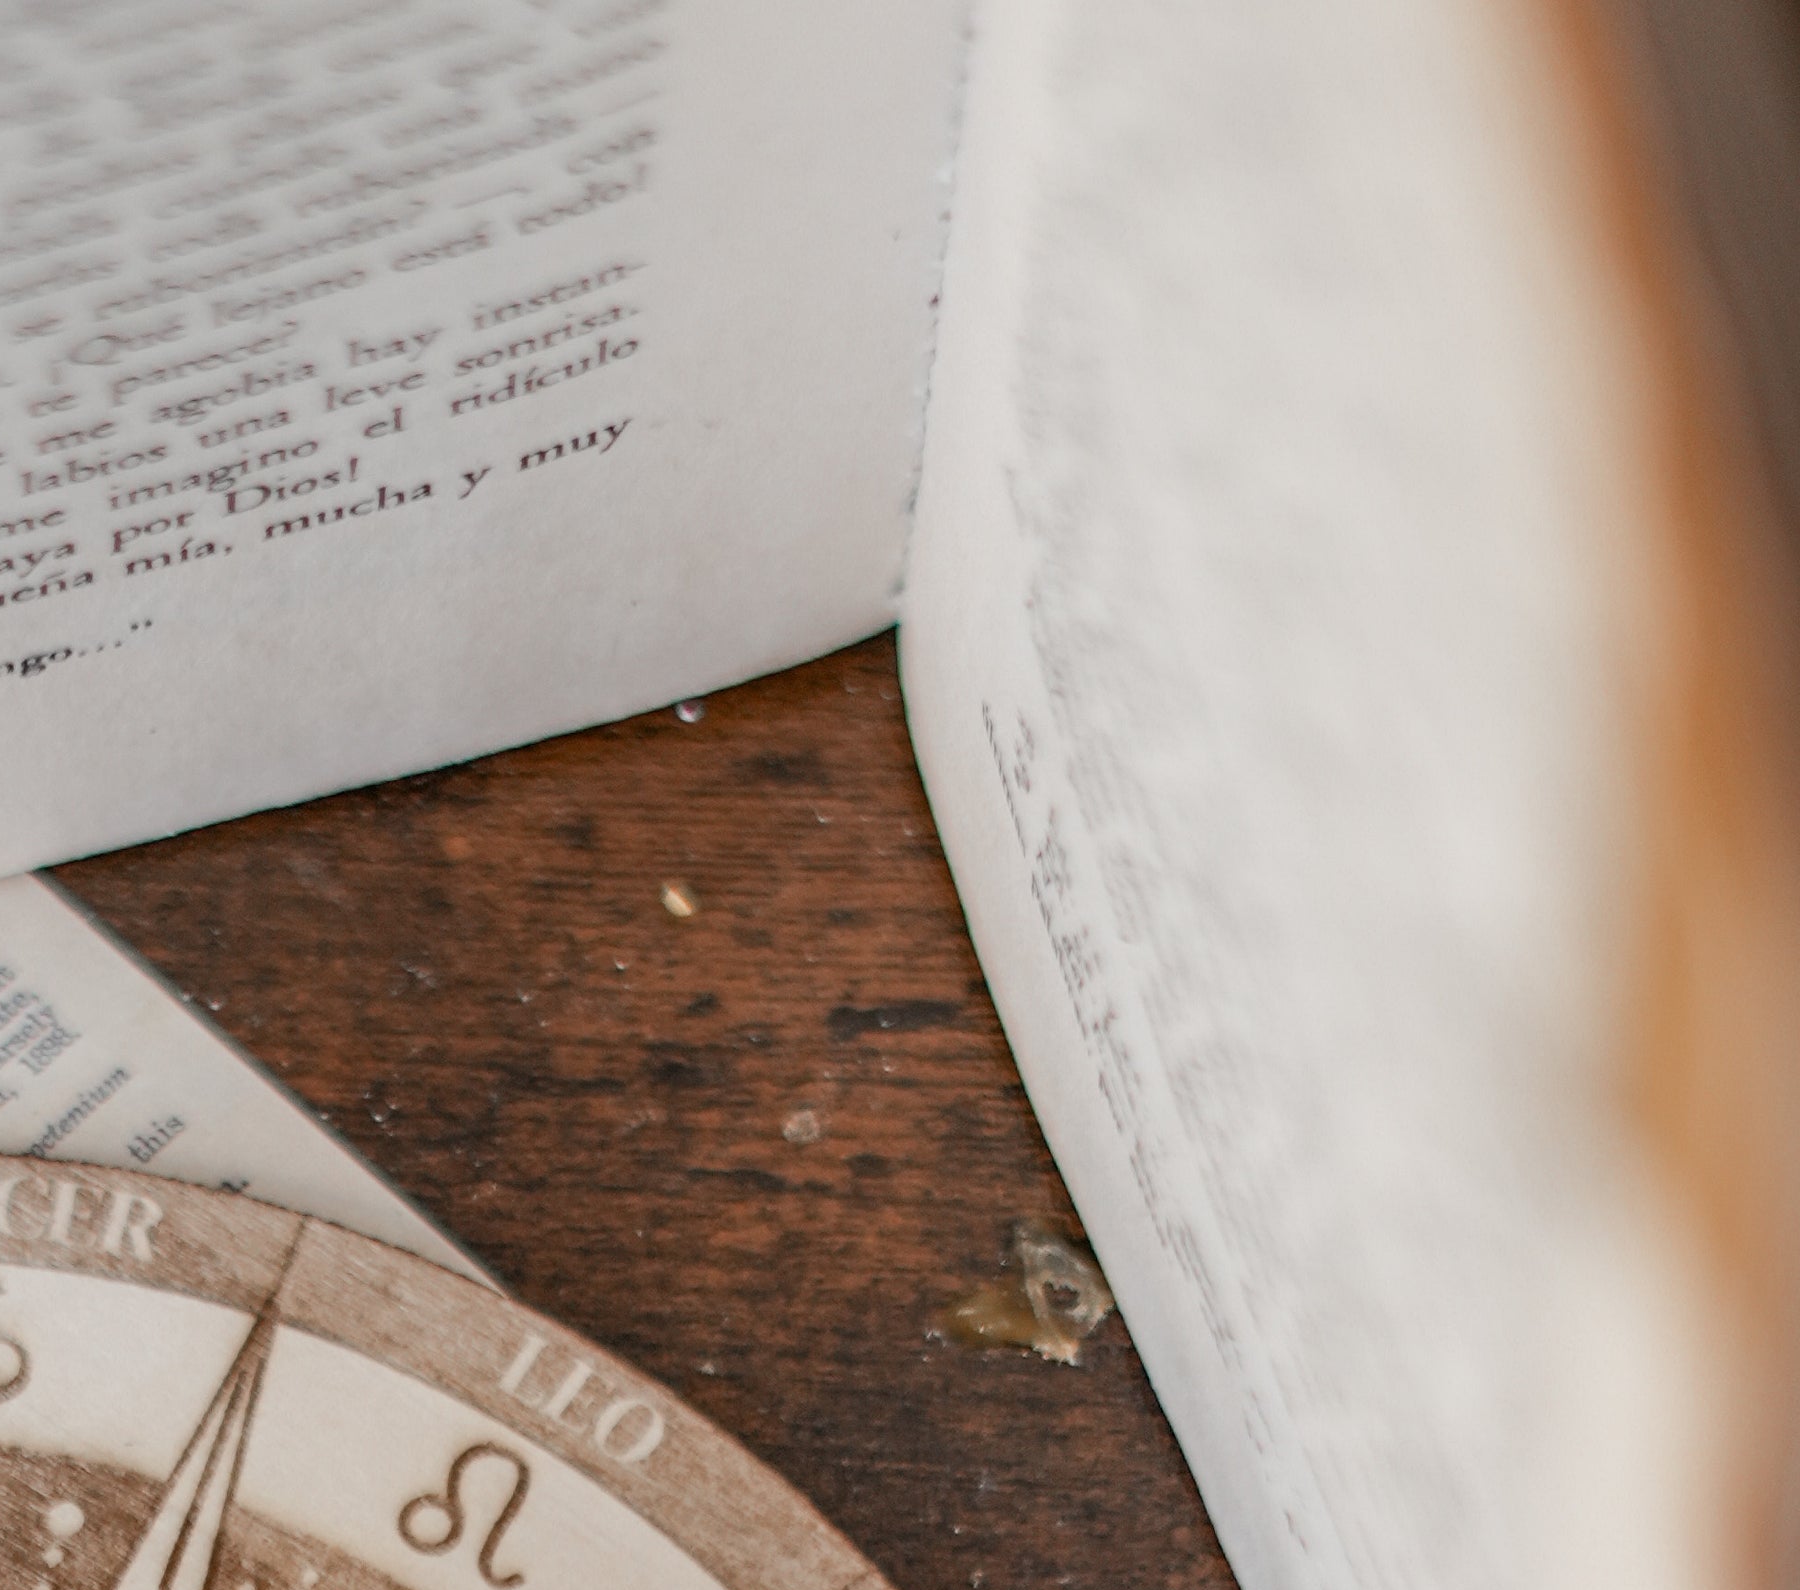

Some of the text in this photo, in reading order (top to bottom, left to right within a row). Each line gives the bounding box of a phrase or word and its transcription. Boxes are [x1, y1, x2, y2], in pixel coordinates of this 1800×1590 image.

[109, 440, 319, 511] imagino
[364, 406, 404, 440] el
[450, 338, 640, 417] ridículo
[199, 410, 291, 449] una
[325, 372, 426, 412] leve
[110, 510, 195, 556] por
[224, 456, 360, 516] Dios!
[124, 536, 234, 576] mía,
[264, 482, 434, 541] mucha
[458, 465, 493, 500] y
[517, 417, 634, 473] muy
[126, 1113, 188, 1166] this
[500, 1332, 665, 1463] LEO
